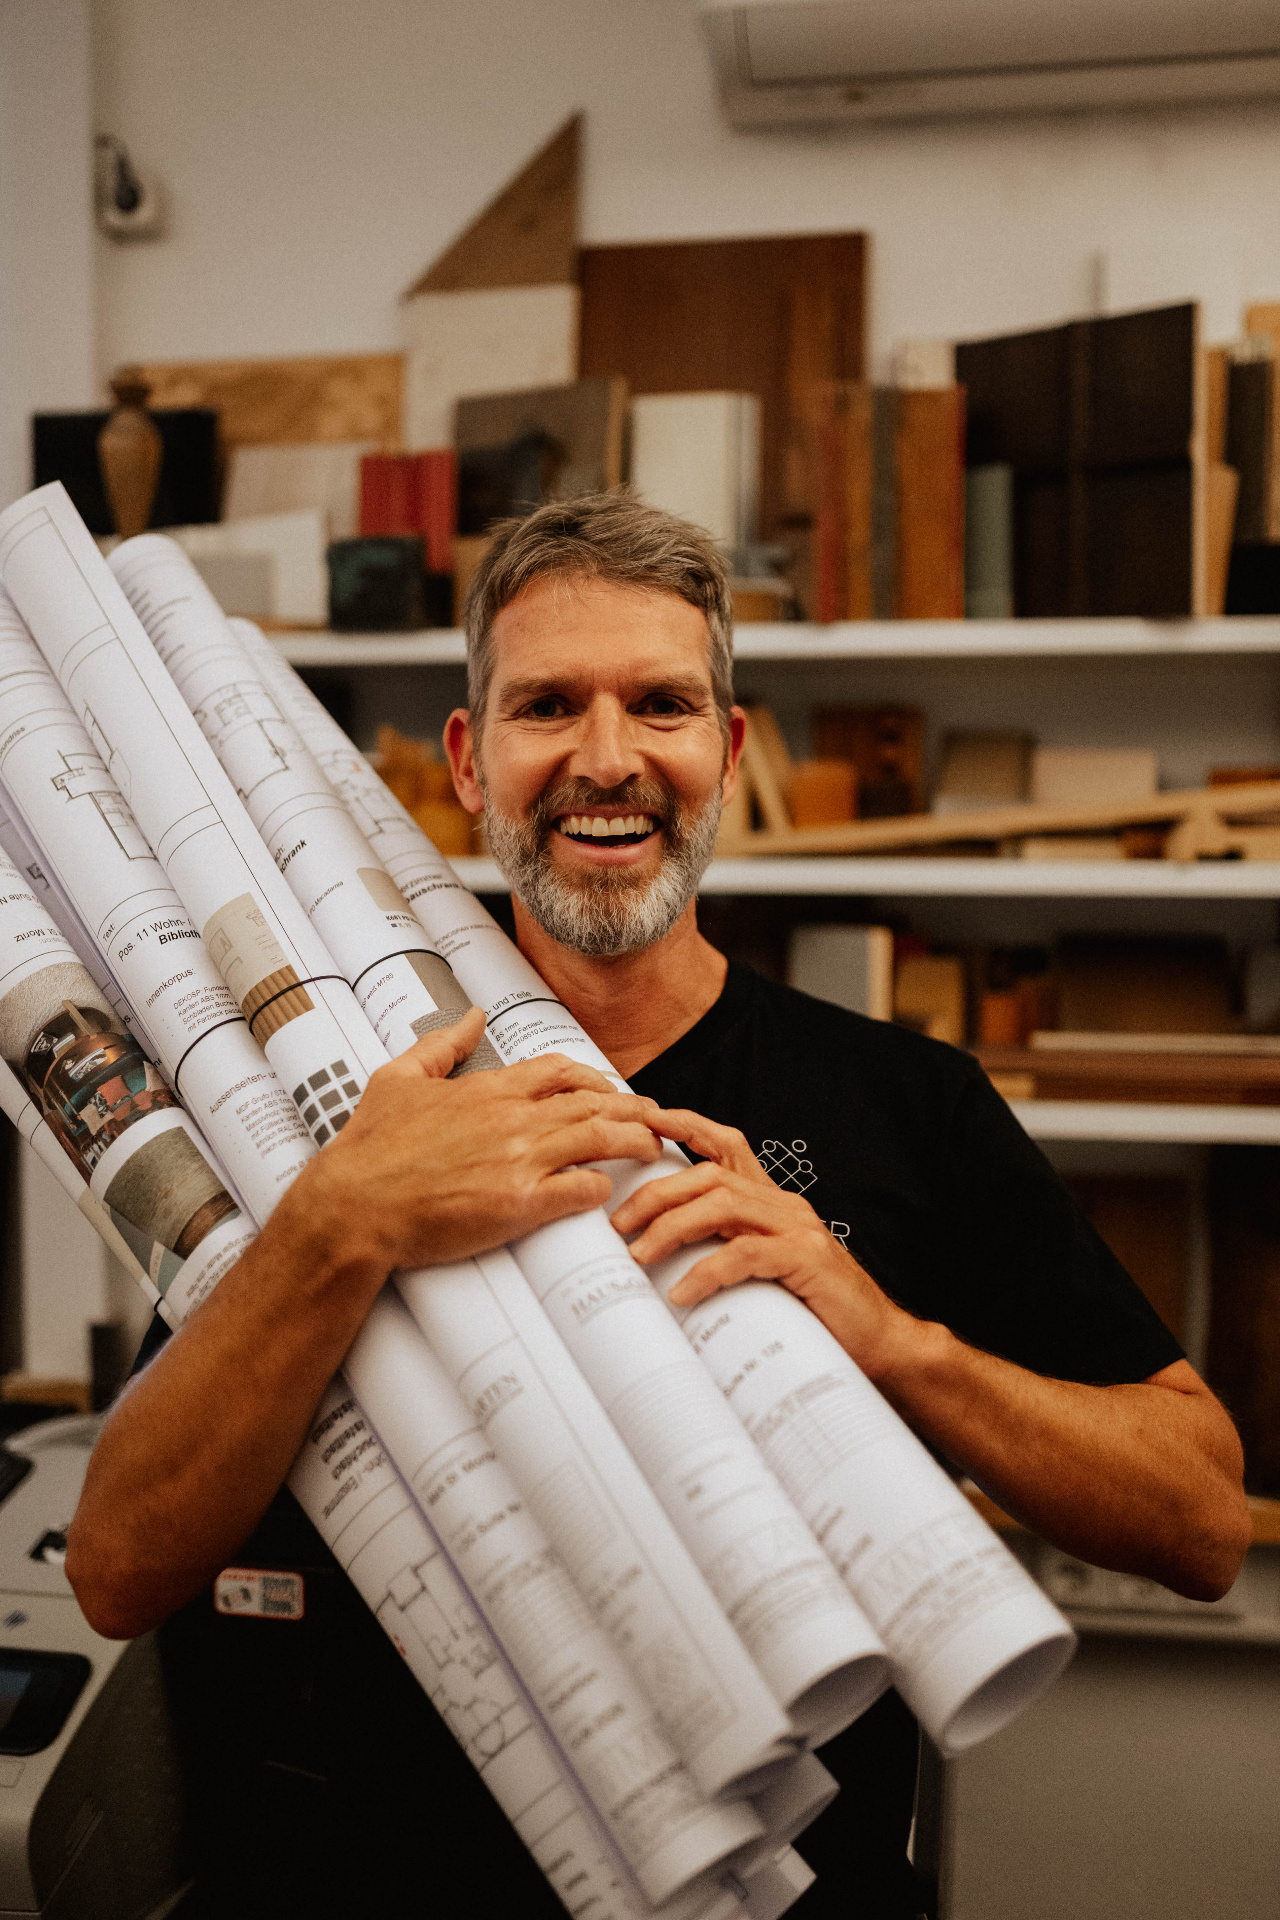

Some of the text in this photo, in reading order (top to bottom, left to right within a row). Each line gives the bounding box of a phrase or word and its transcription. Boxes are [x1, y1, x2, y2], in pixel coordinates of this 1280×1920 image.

[14, 928, 46, 943] Moritz
[118, 942, 137, 962] Pos.
[136, 928, 149, 942] 11
[149, 917, 187, 934] Wohn-
[145, 967, 197, 1008] Innenkorpus:
[177, 1001, 200, 1018] Kanten
[200, 994, 216, 1006] ABS
[387, 993, 408, 1011] Muster
[492, 997, 510, 1011] und
[197, 1010, 224, 1027] Farblack
[518, 1019, 545, 1034] Farblack
[504, 1021, 519, 1034] 1mm
[208, 1072, 267, 1116] Aussenseiten-
[240, 1106, 263, 1124] Kanten
[263, 1099, 279, 1110] ABS
[277, 1125, 294, 1135] RAL
